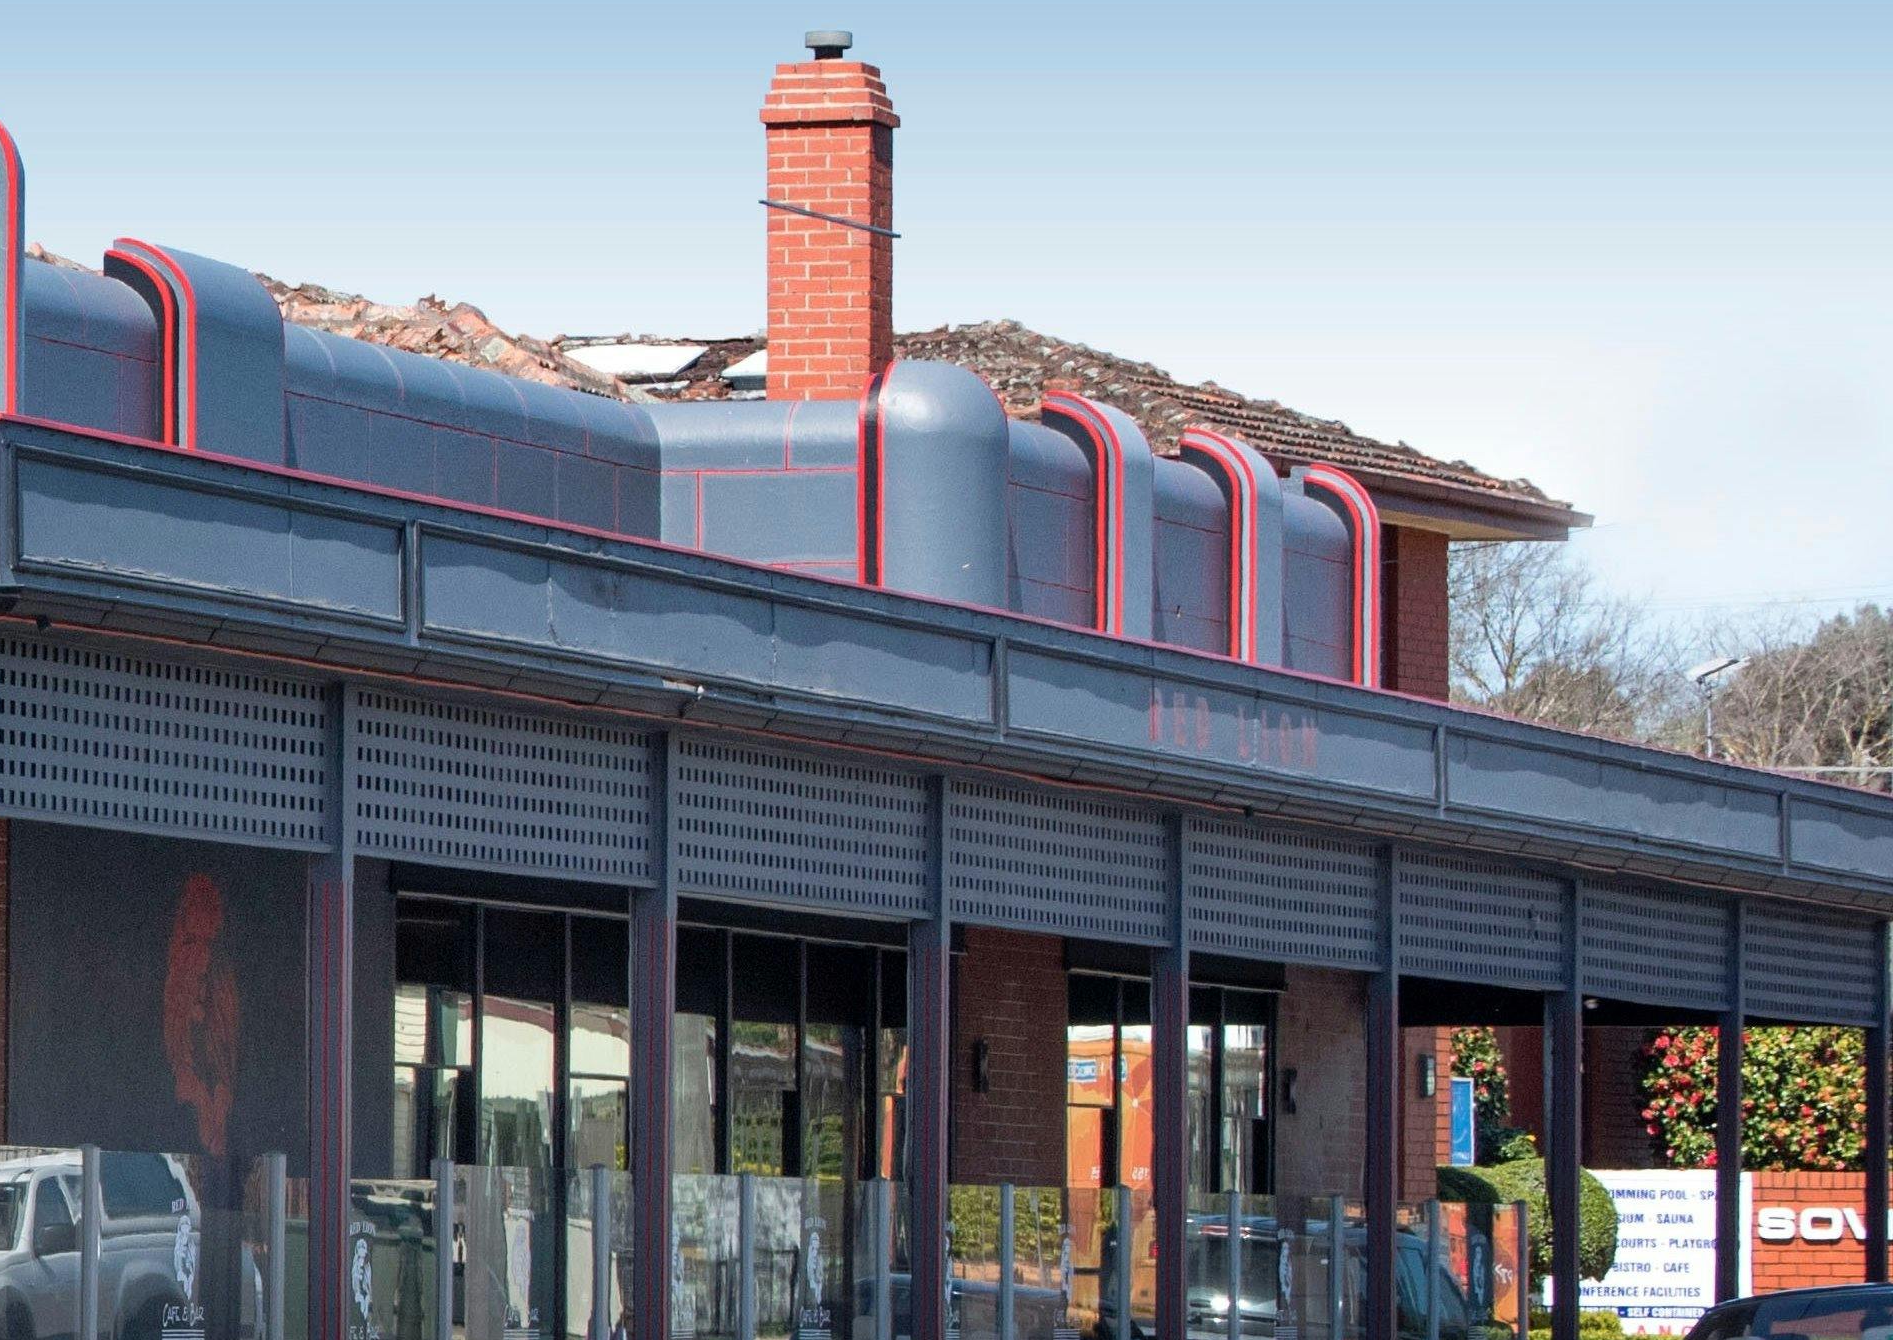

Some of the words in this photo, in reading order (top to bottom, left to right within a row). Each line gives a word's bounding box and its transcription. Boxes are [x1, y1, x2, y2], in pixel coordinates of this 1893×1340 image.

[1610, 1189, 1656, 1200] IMMING
[1660, 1189, 1688, 1200] POOL
[1700, 1190, 1716, 1201] SP
[1656, 1213, 1694, 1224] SAUNA
[1612, 1262, 1651, 1273] BISTRO
[1663, 1262, 1690, 1273] CAFE
[1580, 1286, 1639, 1297] NFERENCE
[1643, 1286, 1701, 1298] FACILITIES
